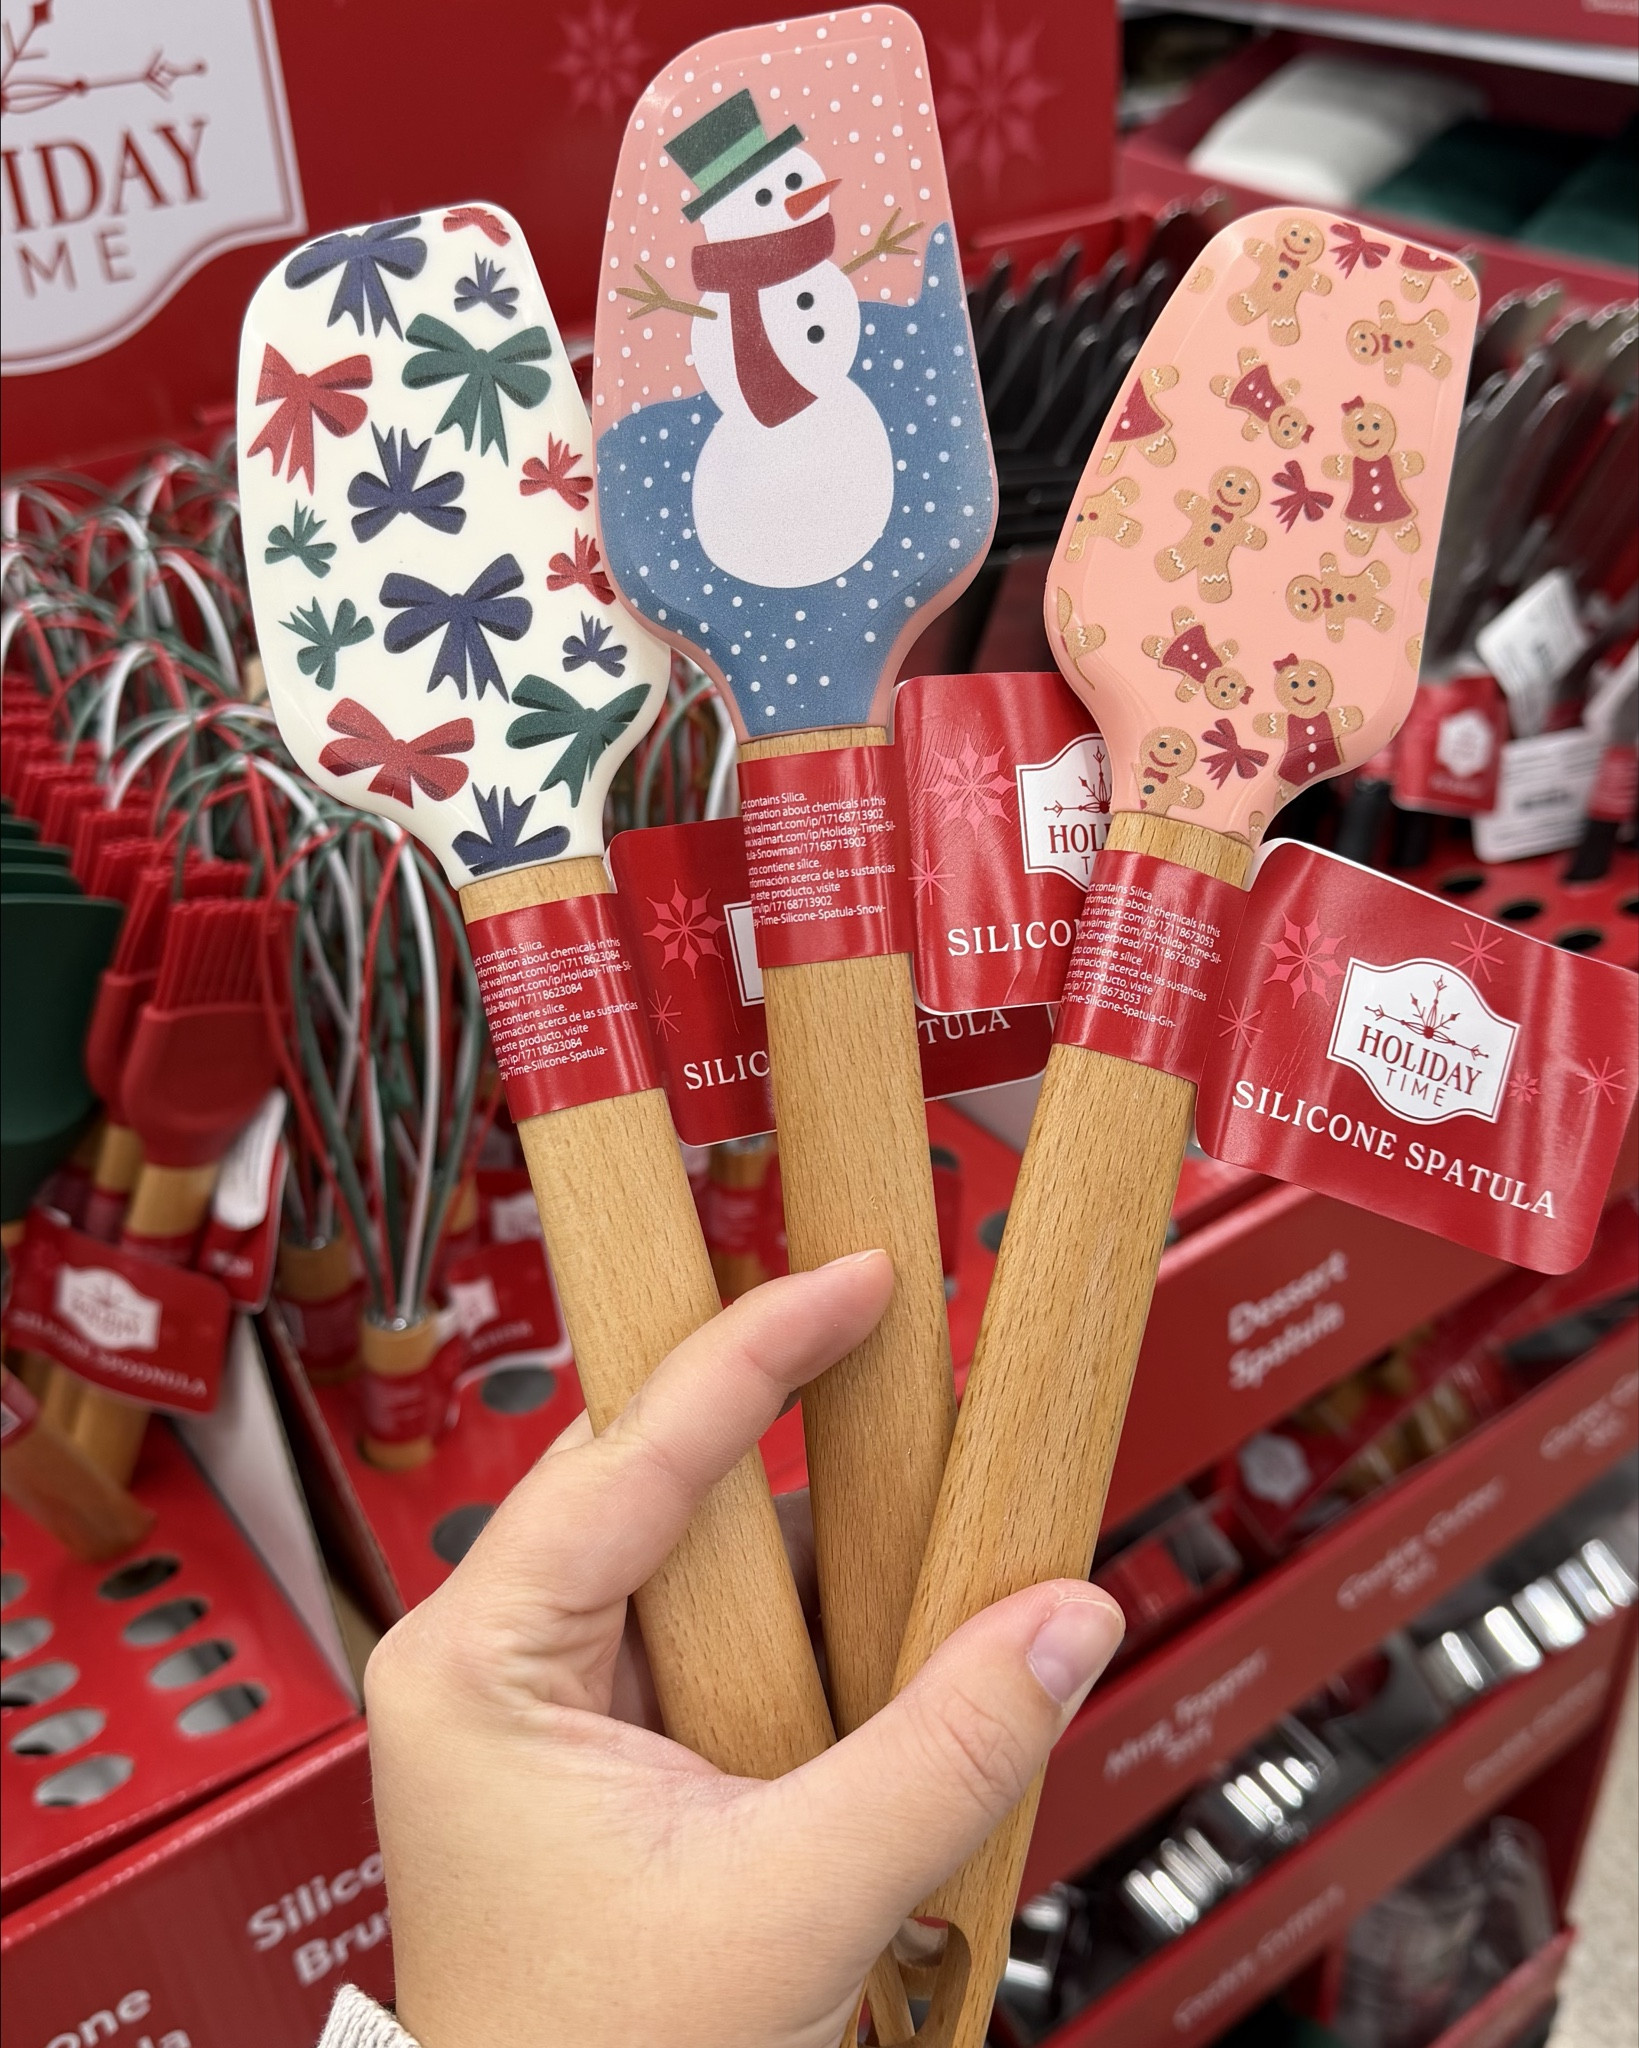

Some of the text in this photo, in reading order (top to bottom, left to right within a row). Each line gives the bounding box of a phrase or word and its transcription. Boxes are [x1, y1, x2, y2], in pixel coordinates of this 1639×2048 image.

[1, 117, 207, 232] IDAY
[17, 225, 135, 298] ME
[747, 795, 780, 808] contains
[781, 792, 807, 803] Silica.
[783, 805, 810, 816] about
[812, 798, 858, 812] chemicals
[860, 797, 869, 807] in
[870, 795, 886, 806] this
[751, 809, 883, 834] walmart.com/ip/17168713902
[1048, 824, 1110, 853] HOL
[759, 862, 795, 874] contiene
[791, 872, 820, 883] acerca
[822, 869, 834, 880] de
[836, 868, 849, 878] las
[851, 864, 895, 877] sustancias
[756, 891, 770, 900] este
[772, 887, 815, 900] producto,
[817, 882, 840, 893] visite
[1095, 883, 1128, 894] contains
[1090, 906, 1214, 948] walmart.com/ip/17118673053
[1126, 898, 1153, 914] about
[1154, 907, 1197, 928] chemicals
[1198, 920, 1205, 932] in
[1207, 924, 1220, 938] this
[522, 952, 548, 966] about
[550, 941, 596, 958] chemicals
[597, 940, 606, 949] in
[607, 937, 620, 947] this
[948, 920, 1080, 956] SILICO
[1083, 946, 1118, 958] contiene
[482, 947, 518, 964] contains
[518, 942, 545, 954] Silica.
[489, 950, 620, 988] walmart.com/ip/17118623084
[1072, 970, 1084, 978] este
[1084, 971, 1127, 989] producto,
[1130, 981, 1153, 995] visite
[1109, 963, 1138, 978] acerca
[1140, 971, 1152, 982] de
[1154, 974, 1166, 986] las
[1167, 980, 1207, 1001] sustancias
[502, 1010, 540, 1026] contiene
[538, 1016, 568, 1030] acerca
[569, 1012, 581, 1022] de
[582, 1009, 596, 1019] las
[597, 1001, 638, 1016] sustancias
[502, 1042, 517, 1052] este
[519, 1031, 564, 1050] producto,
[564, 1024, 589, 1036] visite
[684, 1009, 1011, 1090] SILIC TULA
[1357, 1024, 1482, 1095] HOLIDAY
[1386, 1067, 1446, 1107] TIME
[1232, 1080, 1558, 1219] SILICONE SPATULA
[292, 1906, 392, 1986] Bru
